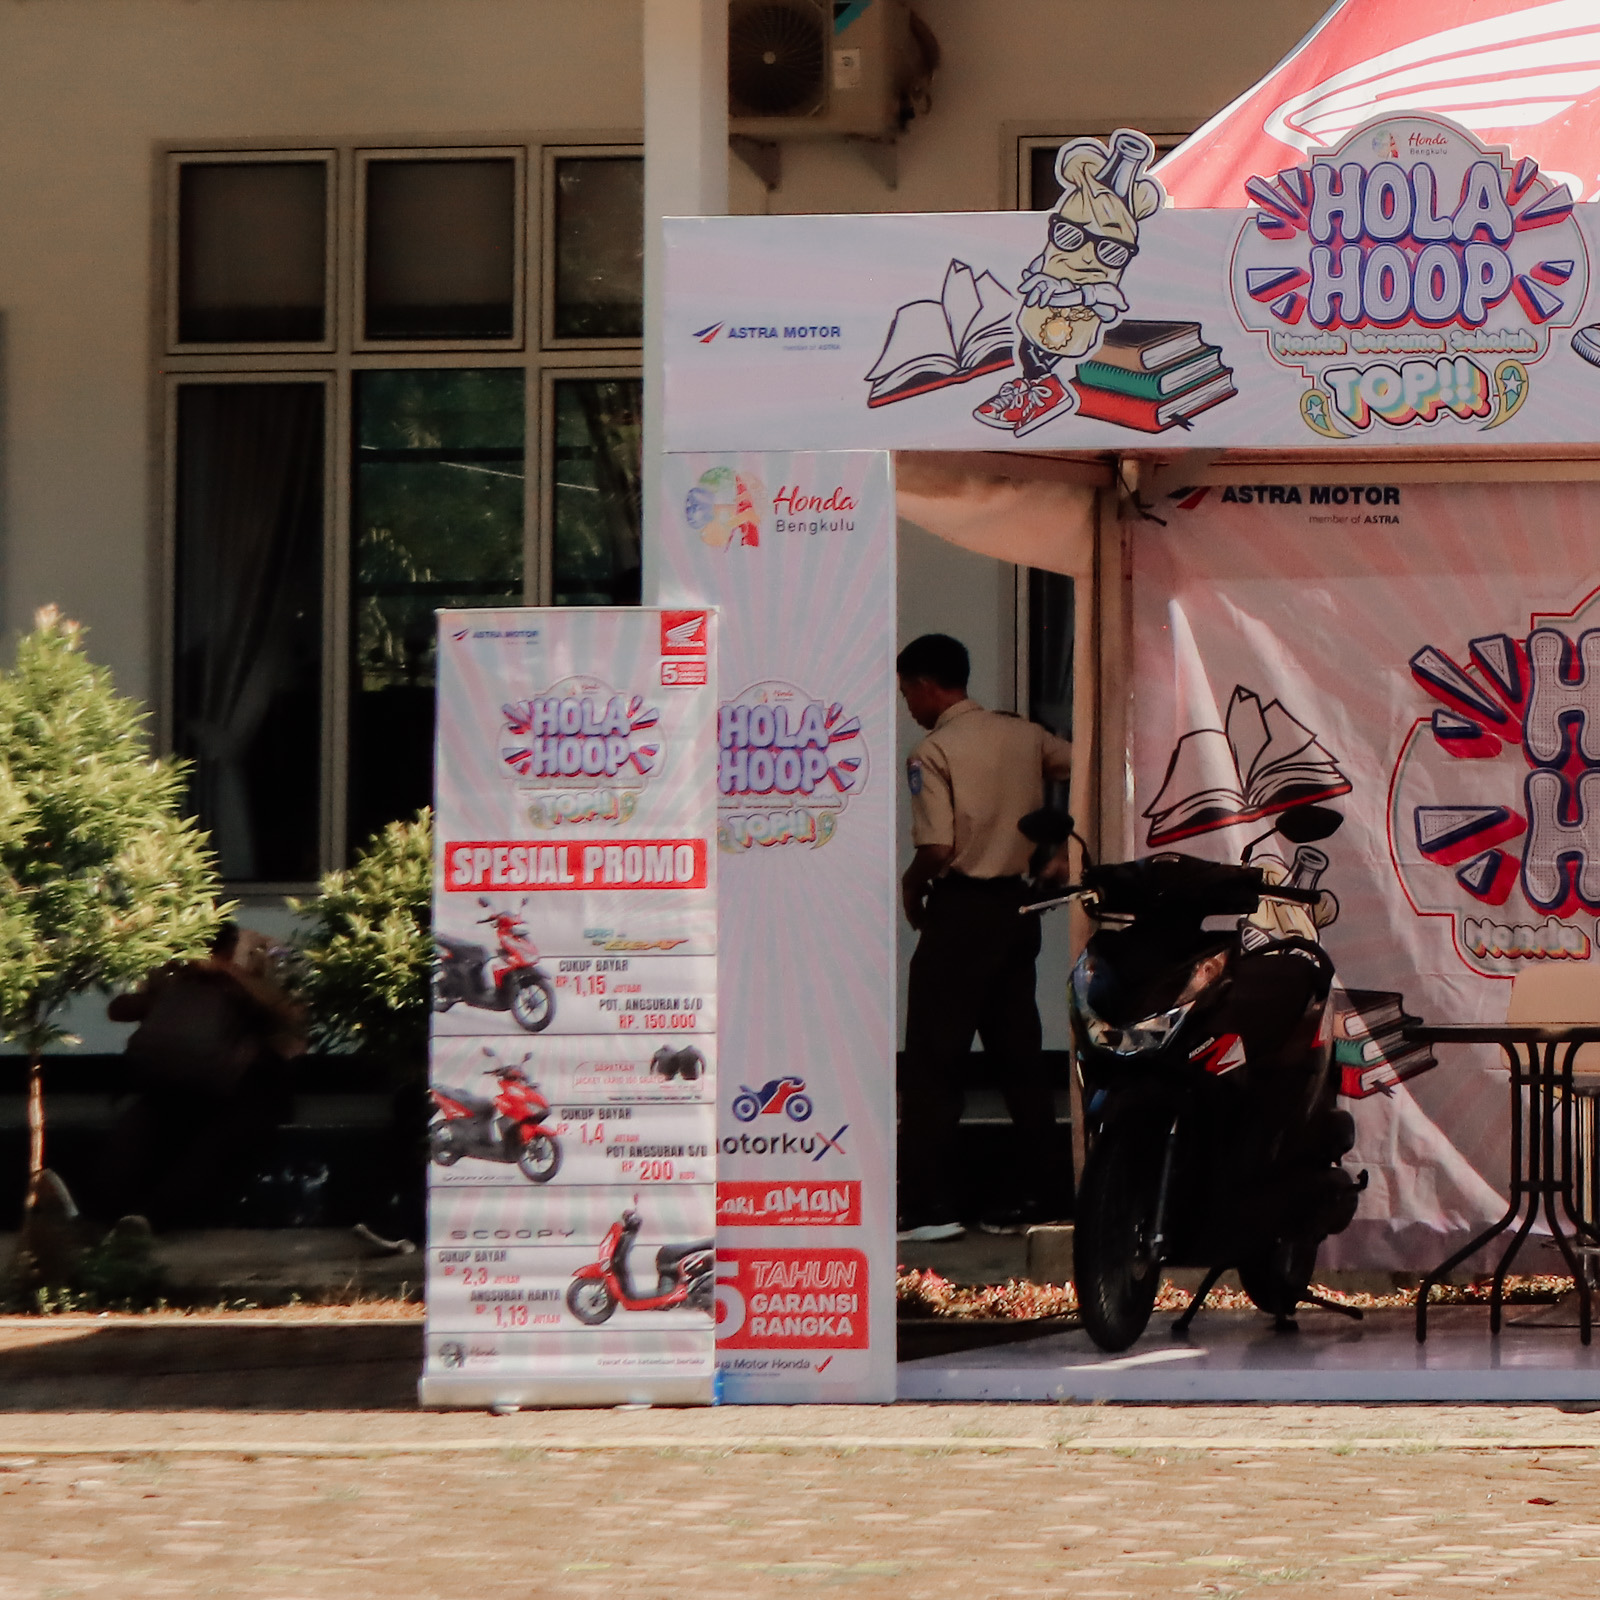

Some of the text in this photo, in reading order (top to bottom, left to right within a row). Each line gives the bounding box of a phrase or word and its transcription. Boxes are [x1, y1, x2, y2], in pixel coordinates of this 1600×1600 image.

[1408, 131, 1449, 148] Honda
[1410, 147, 1448, 157] Bengkulu
[1309, 160, 1514, 247] HOLA
[1309, 241, 1513, 328] HOOP
[728, 326, 841, 339] ASTRA MOTOR
[1274, 328, 1538, 355] Honda Bersama Sekolah
[1324, 355, 1492, 429] TOP!!
[773, 486, 857, 516] Honda
[1221, 485, 1400, 505] ASTRA MOTOR
[776, 519, 855, 535] Bengkulu
[1309, 514, 1400, 524] member of ASTRA
[505, 630, 539, 639] MOTOR
[662, 663, 679, 684] 5
[533, 697, 631, 737] HOLA
[718, 704, 831, 750] HOLA
[532, 735, 632, 778] HOOP
[718, 748, 830, 796] HOOP
[452, 845, 694, 886] SPESIAL PROMO
[1464, 916, 1591, 959] Honda
[559, 959, 629, 972] CUKUP BAYAR
[573, 975, 606, 997] 1,15
[599, 998, 703, 1011] POT. ANGSURAN S/D
[644, 1014, 697, 1029] 150.000
[561, 1107, 632, 1120] CUKUP BAYAR
[580, 1123, 605, 1146] 1,4
[606, 1145, 708, 1158] POT ANGSURAN S/D
[640, 1160, 673, 1181] 200
[451, 1229, 576, 1240] SCOOPY
[438, 1250, 507, 1263] CUKUP BAYAR
[462, 1267, 488, 1286] 2,3
[752, 1261, 857, 1289] TAHUN
[471, 1289, 561, 1302] ANGSURAN HANYA
[751, 1293, 858, 1314] GARANSI
[494, 1305, 529, 1328] 1,13
[751, 1316, 853, 1337] RANGKA
[734, 1358, 769, 1369] Motor
[772, 1358, 810, 1369] Honda
